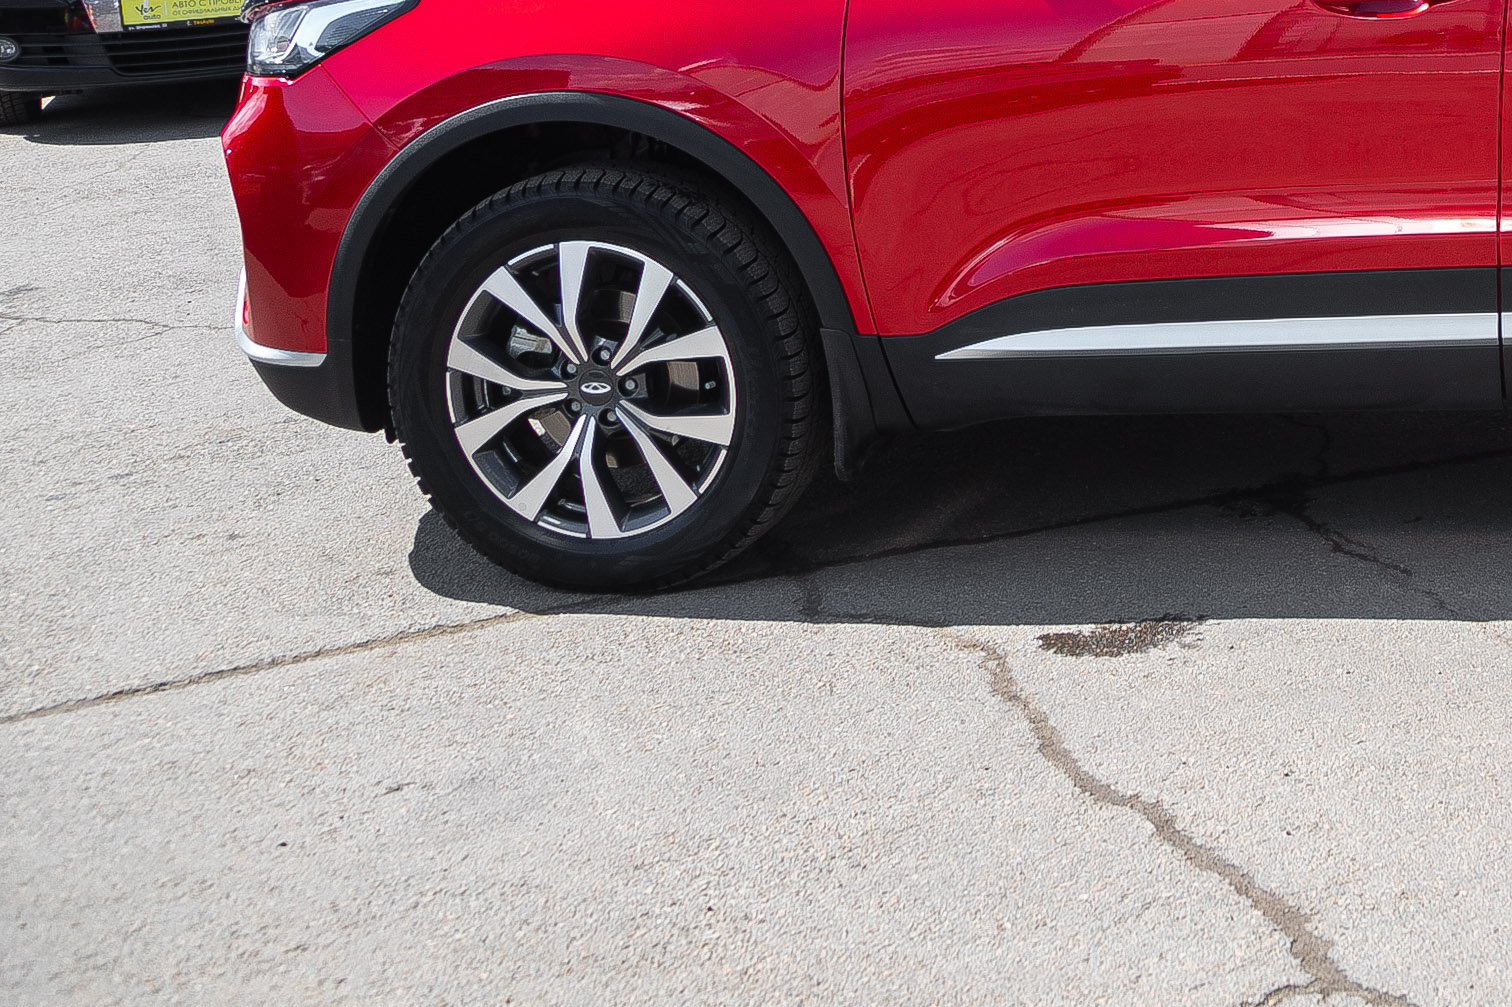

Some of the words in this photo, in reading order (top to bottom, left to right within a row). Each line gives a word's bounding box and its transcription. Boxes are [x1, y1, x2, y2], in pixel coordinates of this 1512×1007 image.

[135, 3, 162, 15] Yes
[171, 0, 197, 9] АВТО
[143, 13, 161, 21] auto
